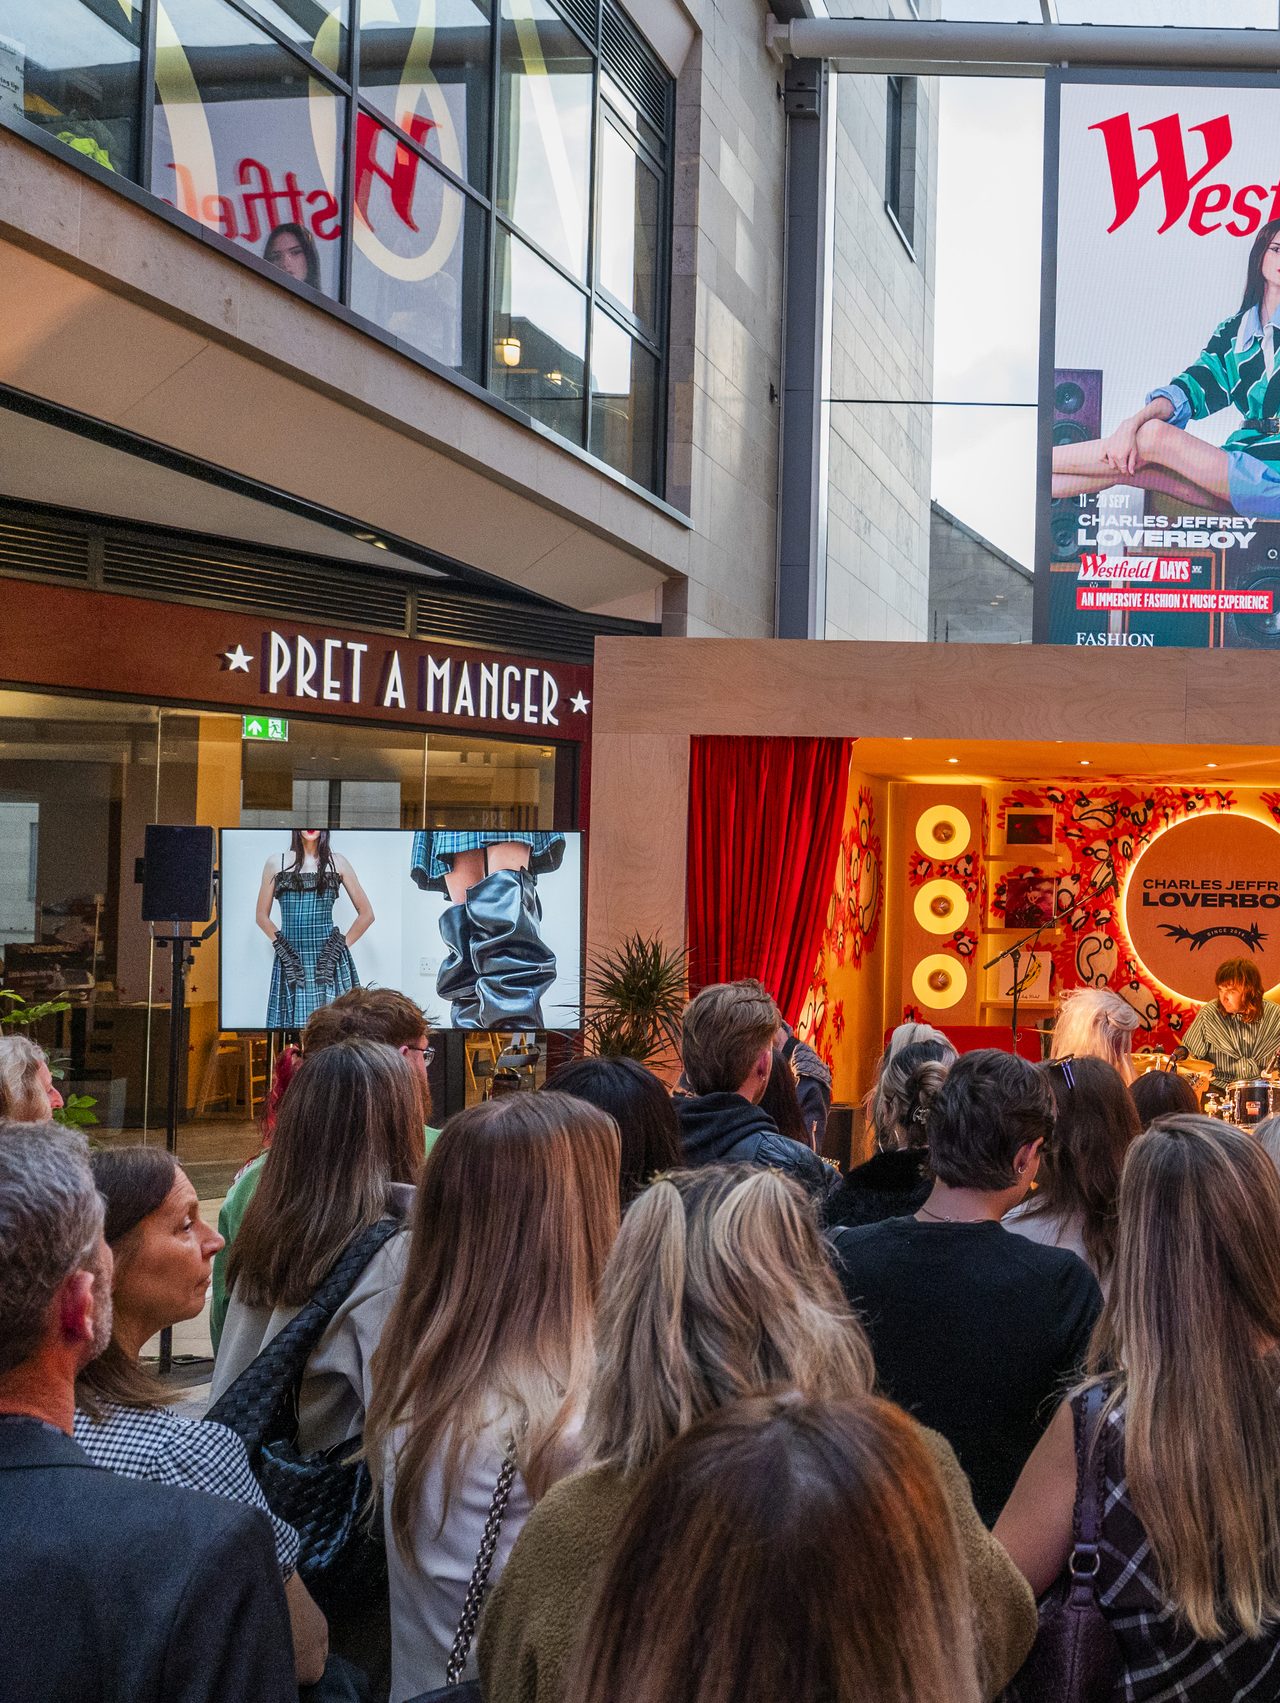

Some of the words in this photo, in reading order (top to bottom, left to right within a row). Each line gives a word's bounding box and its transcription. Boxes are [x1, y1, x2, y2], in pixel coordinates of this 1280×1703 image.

[1078, 514, 1169, 528] CHARLES
[1171, 516, 1257, 529] JEFFREY
[1077, 529, 1257, 549] LOVERBOY
[1080, 552, 1153, 579] Westfield
[1159, 560, 1190, 580] DAYS
[1081, 592, 1094, 606] AN
[1096, 592, 1142, 607] IMMERSIVE
[1144, 594, 1181, 608] FASHION
[1182, 595, 1188, 608] X
[1190, 595, 1216, 609] MUSIC
[1218, 596, 1269, 610] EXPERIENCE
[1075, 632, 1154, 647] FASHION
[269, 630, 368, 703] PRET
[383, 650, 406, 708] A
[426, 654, 560, 726] MANGER
[1143, 879, 1222, 890] CHARLES
